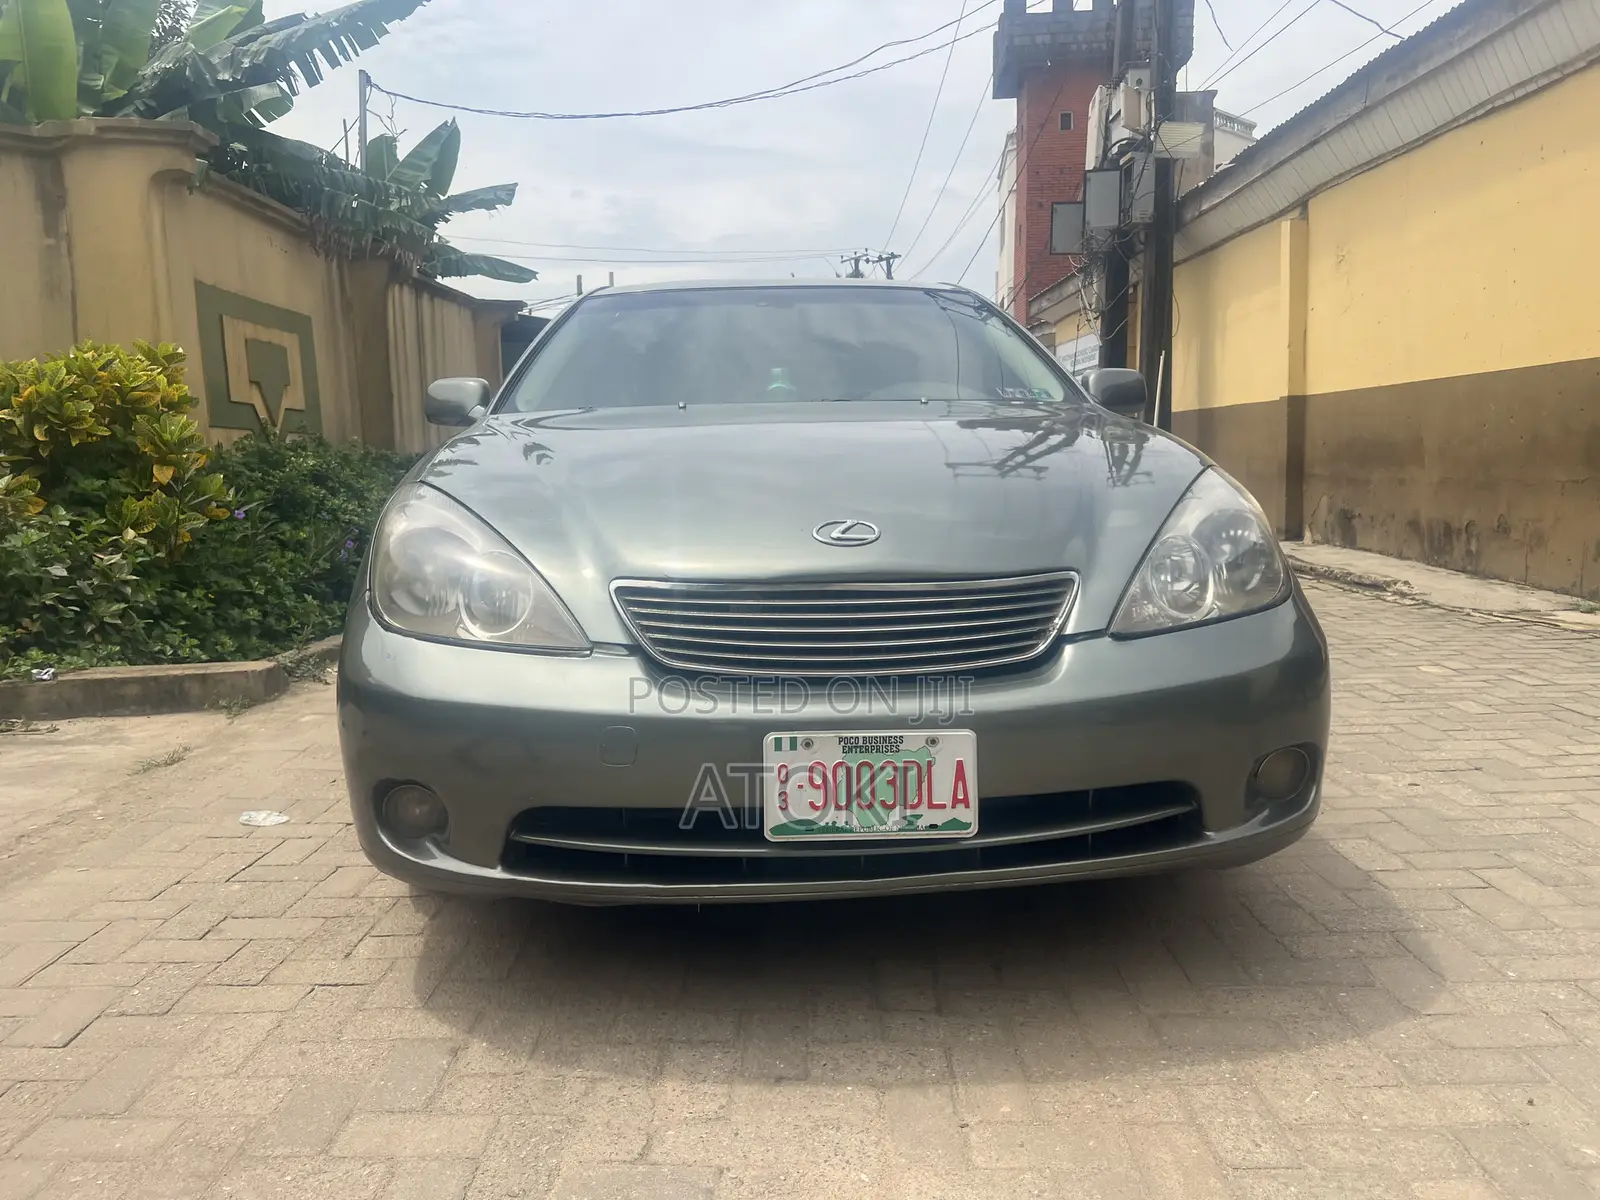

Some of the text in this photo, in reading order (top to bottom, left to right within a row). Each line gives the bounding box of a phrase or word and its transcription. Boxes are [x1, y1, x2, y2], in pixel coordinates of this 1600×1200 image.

[838, 735, 904, 746] POCO BUSINESS
[842, 744, 901, 755] ENTERPRISES
